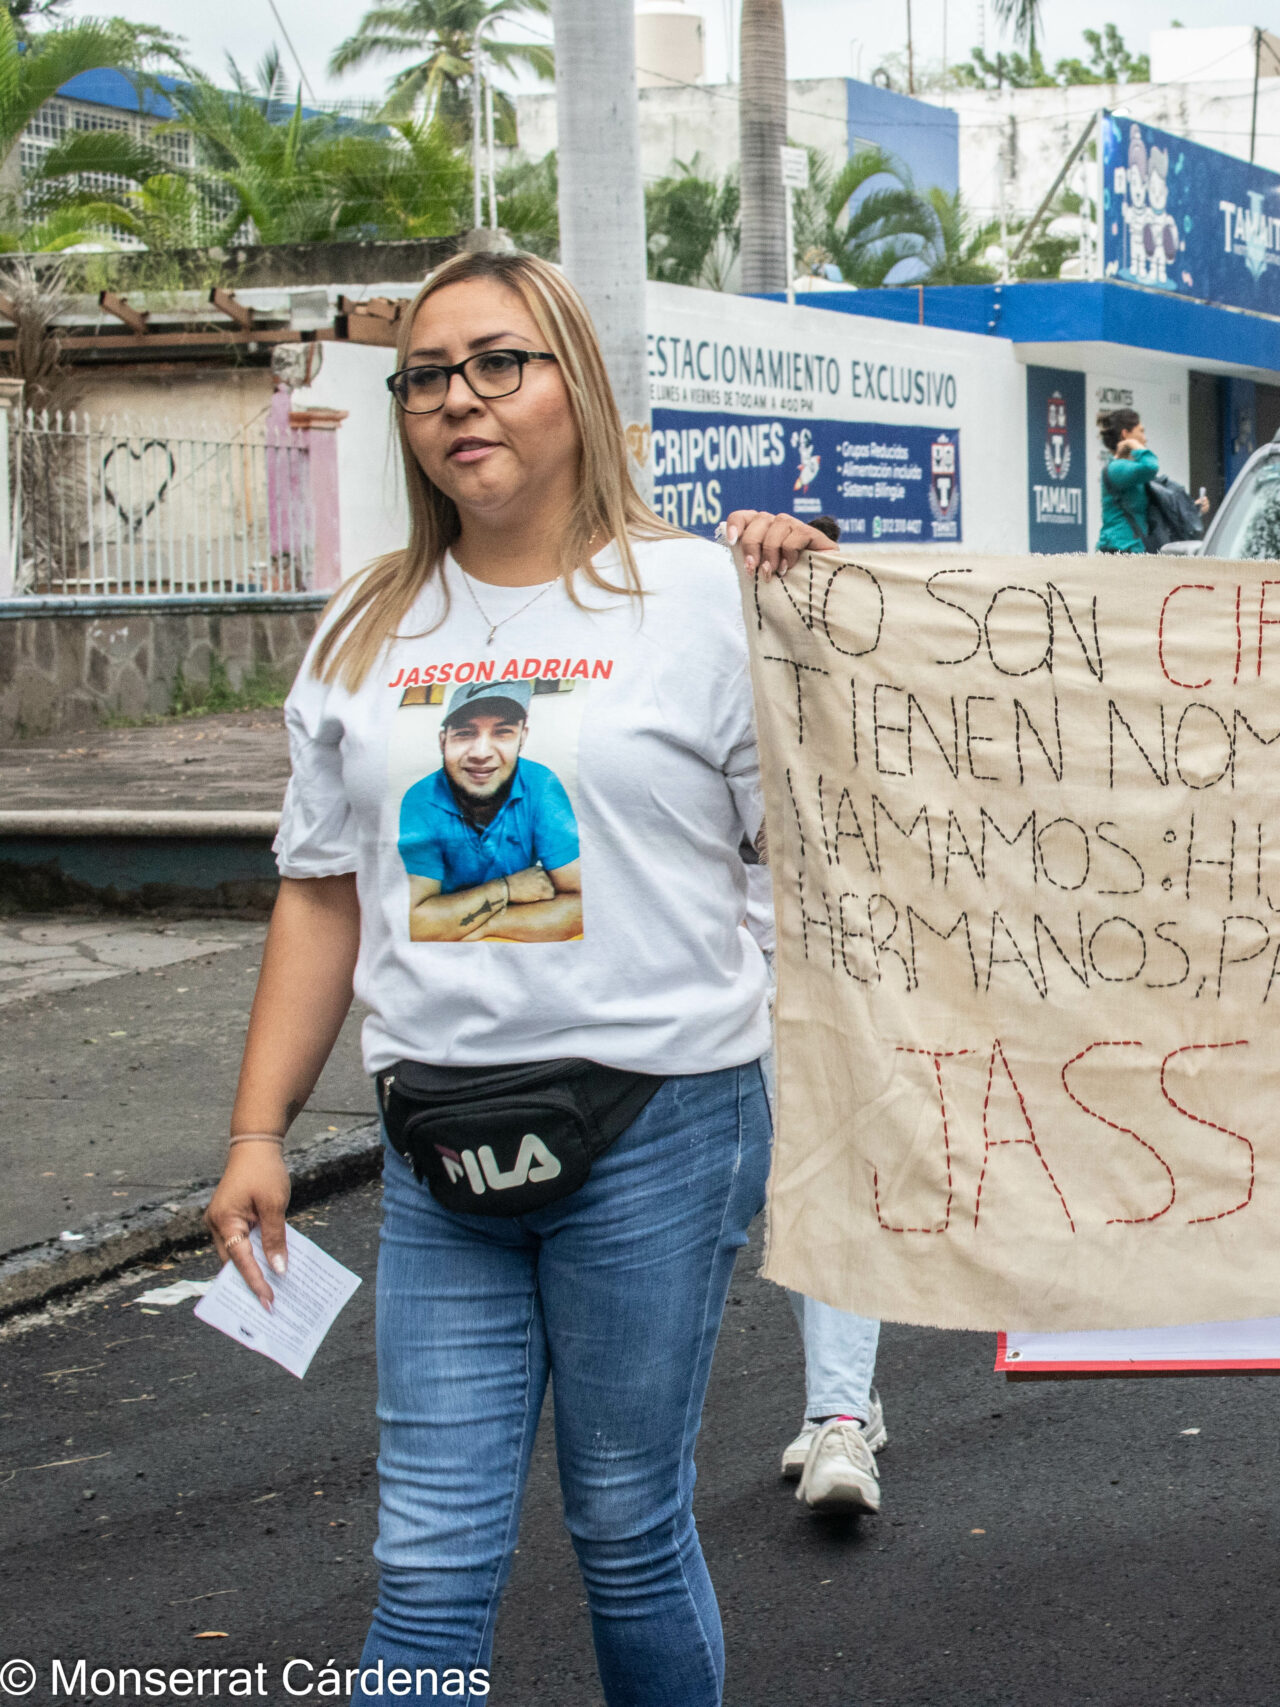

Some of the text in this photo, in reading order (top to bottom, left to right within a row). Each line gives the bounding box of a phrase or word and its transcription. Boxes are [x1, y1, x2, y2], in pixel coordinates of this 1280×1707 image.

[852, 360, 957, 408] EXCLUSIVO
[651, 422, 785, 477] CRIPCIONES
[1033, 485, 1082, 525] TAMAITI
[754, 555, 884, 657] NO
[926, 569, 1103, 683] SON
[388, 658, 613, 688] JASSON ADRIAN
[763, 656, 1063, 787] TIENEN
